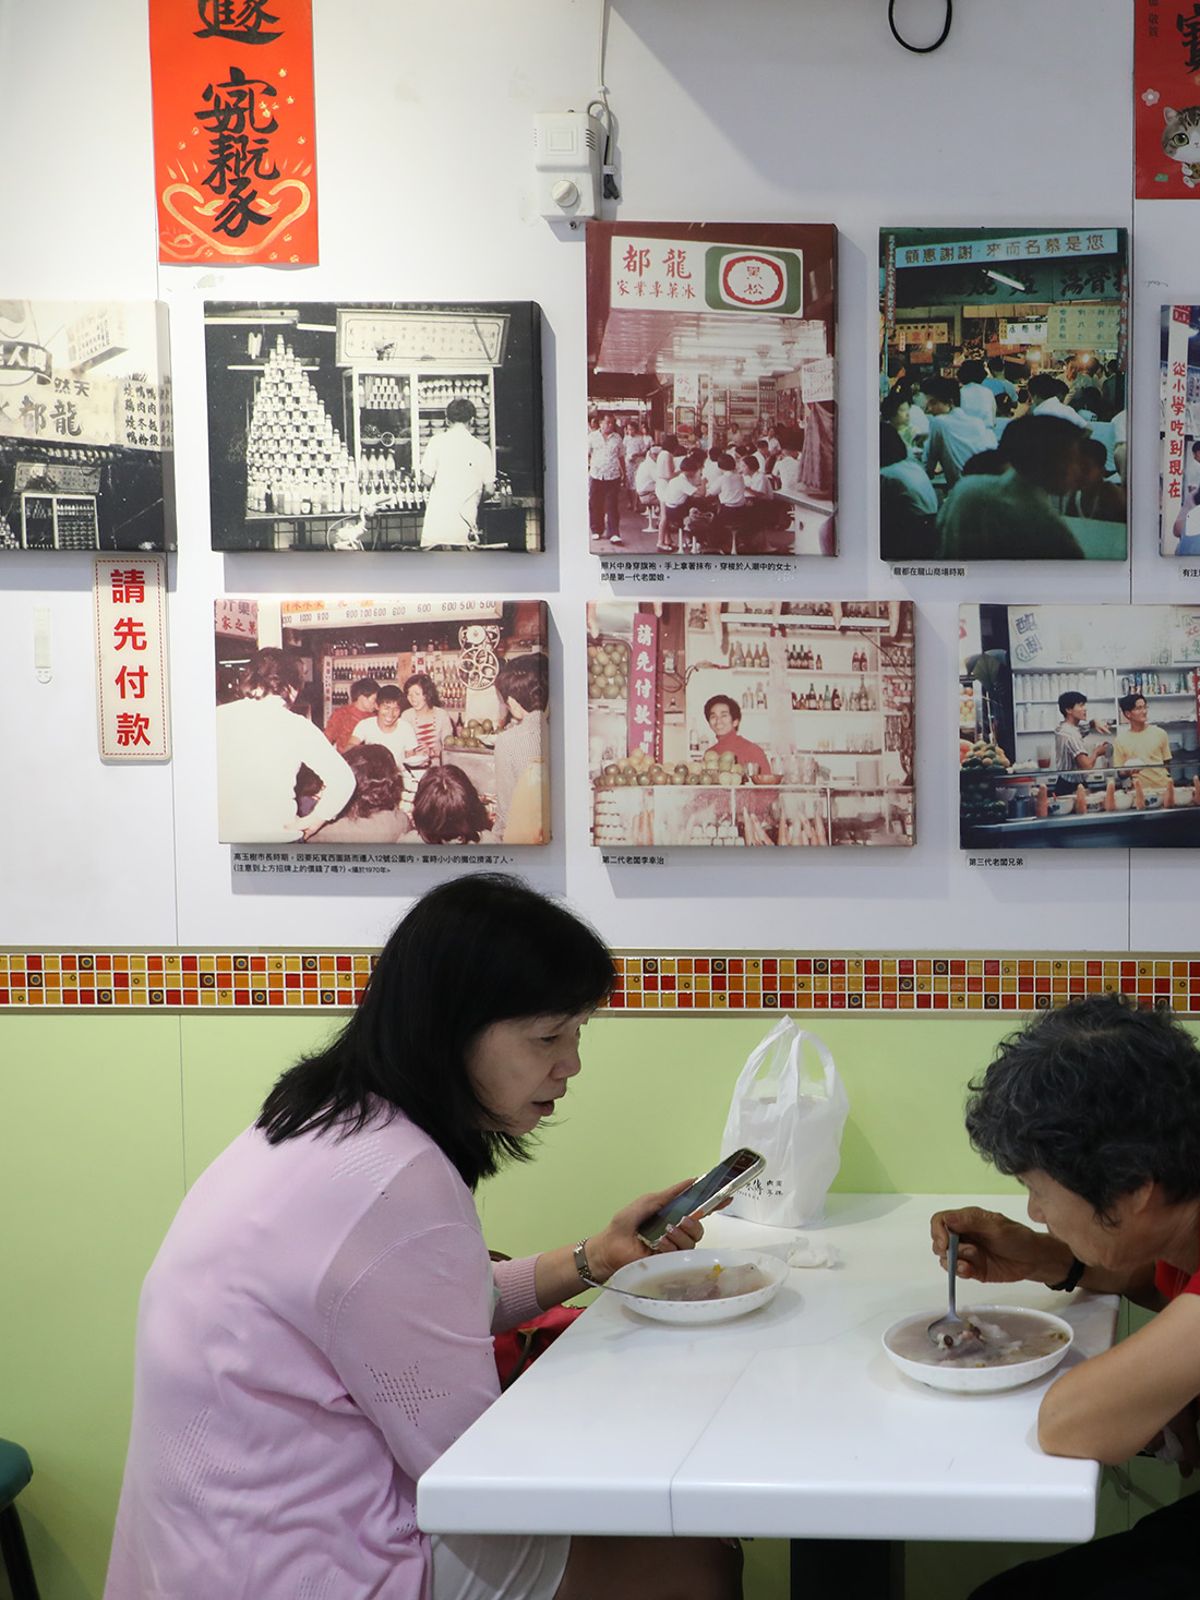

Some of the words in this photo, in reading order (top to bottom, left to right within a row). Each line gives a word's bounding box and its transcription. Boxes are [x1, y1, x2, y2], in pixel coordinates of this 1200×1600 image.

[1167, 361, 1186, 499] 從小學吃到現在
[110, 568, 152, 747] 請先付款
[968, 857, 1024, 867] 第三代老闆兄弟
